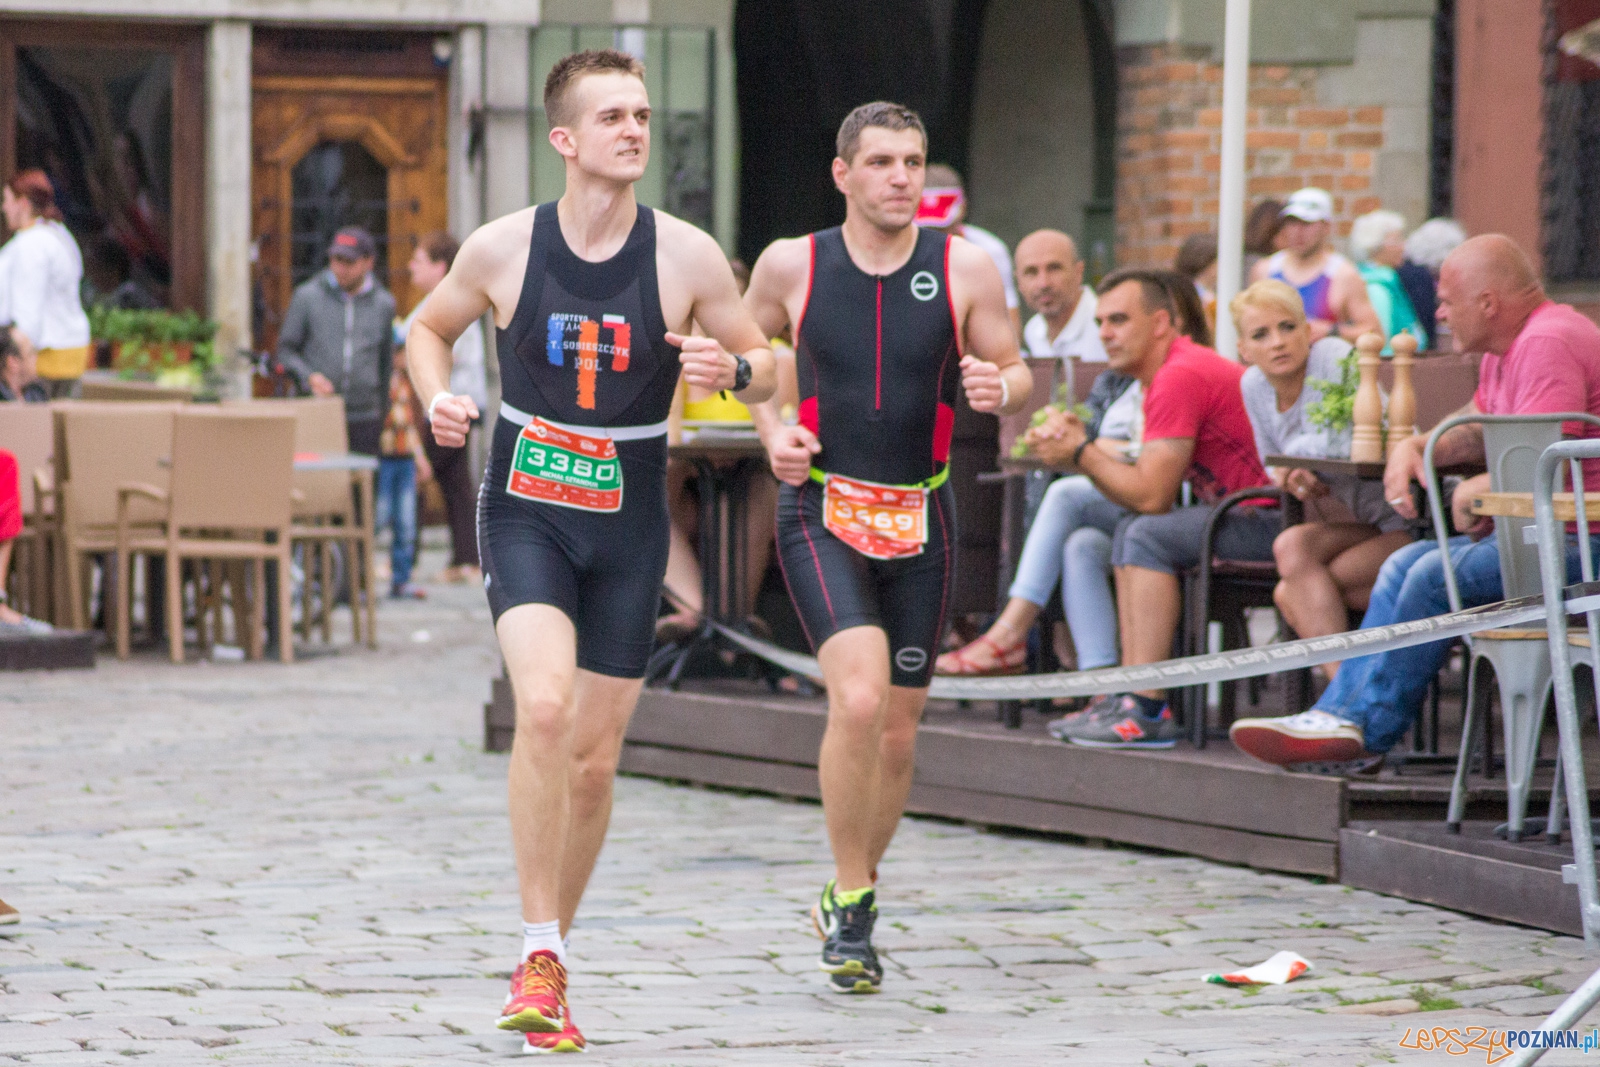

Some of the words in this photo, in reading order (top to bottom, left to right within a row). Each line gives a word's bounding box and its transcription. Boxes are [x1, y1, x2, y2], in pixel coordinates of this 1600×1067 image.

[550, 312, 589, 323] SPORTEVO
[562, 340, 630, 358] SOBIESZCZYK
[574, 356, 603, 372] POL
[526, 446, 616, 481] 3380
